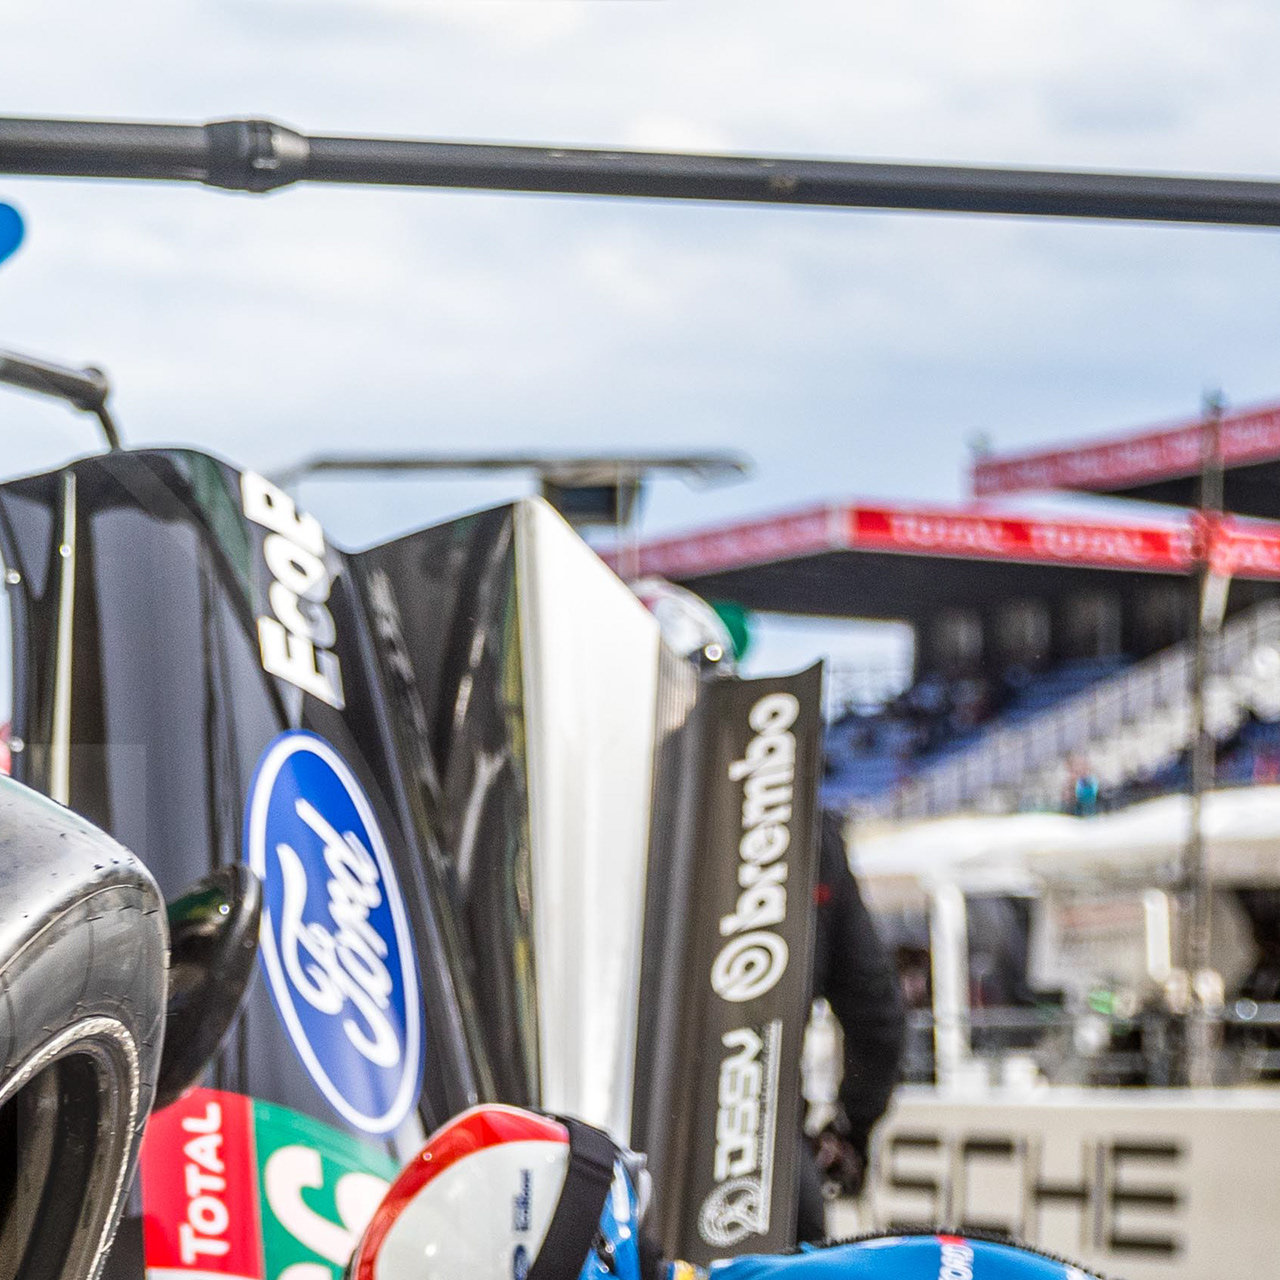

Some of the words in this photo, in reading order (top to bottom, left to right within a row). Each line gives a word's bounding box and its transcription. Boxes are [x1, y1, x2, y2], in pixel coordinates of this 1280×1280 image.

[276, 798, 400, 1069] Ford
[721, 692, 799, 937] brembo
[178, 1101, 231, 1265] TOTAL
